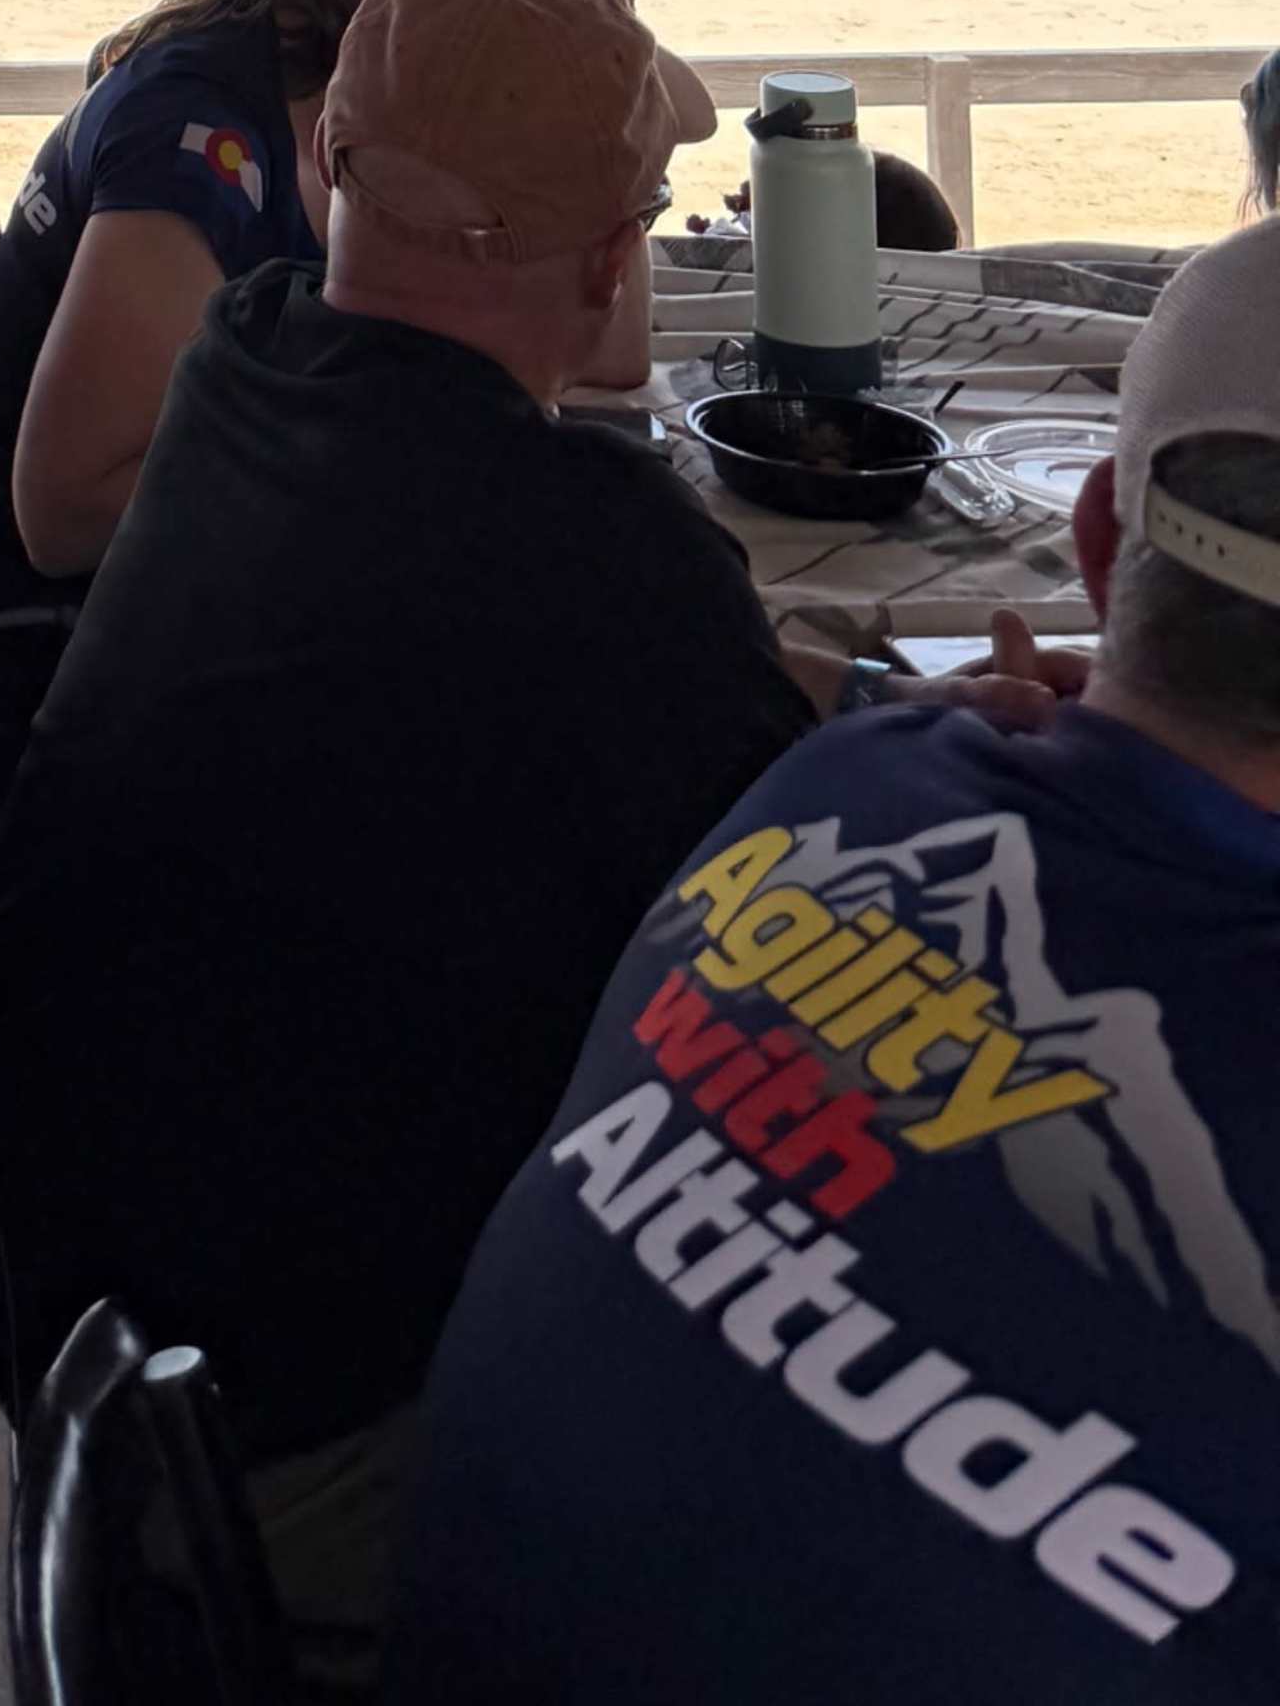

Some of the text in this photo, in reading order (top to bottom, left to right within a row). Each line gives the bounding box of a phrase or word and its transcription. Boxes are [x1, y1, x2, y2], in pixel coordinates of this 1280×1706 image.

[634, 967, 897, 1218] with
[677, 826, 1112, 1154] Agility
[551, 1081, 1236, 1646] Altitude
